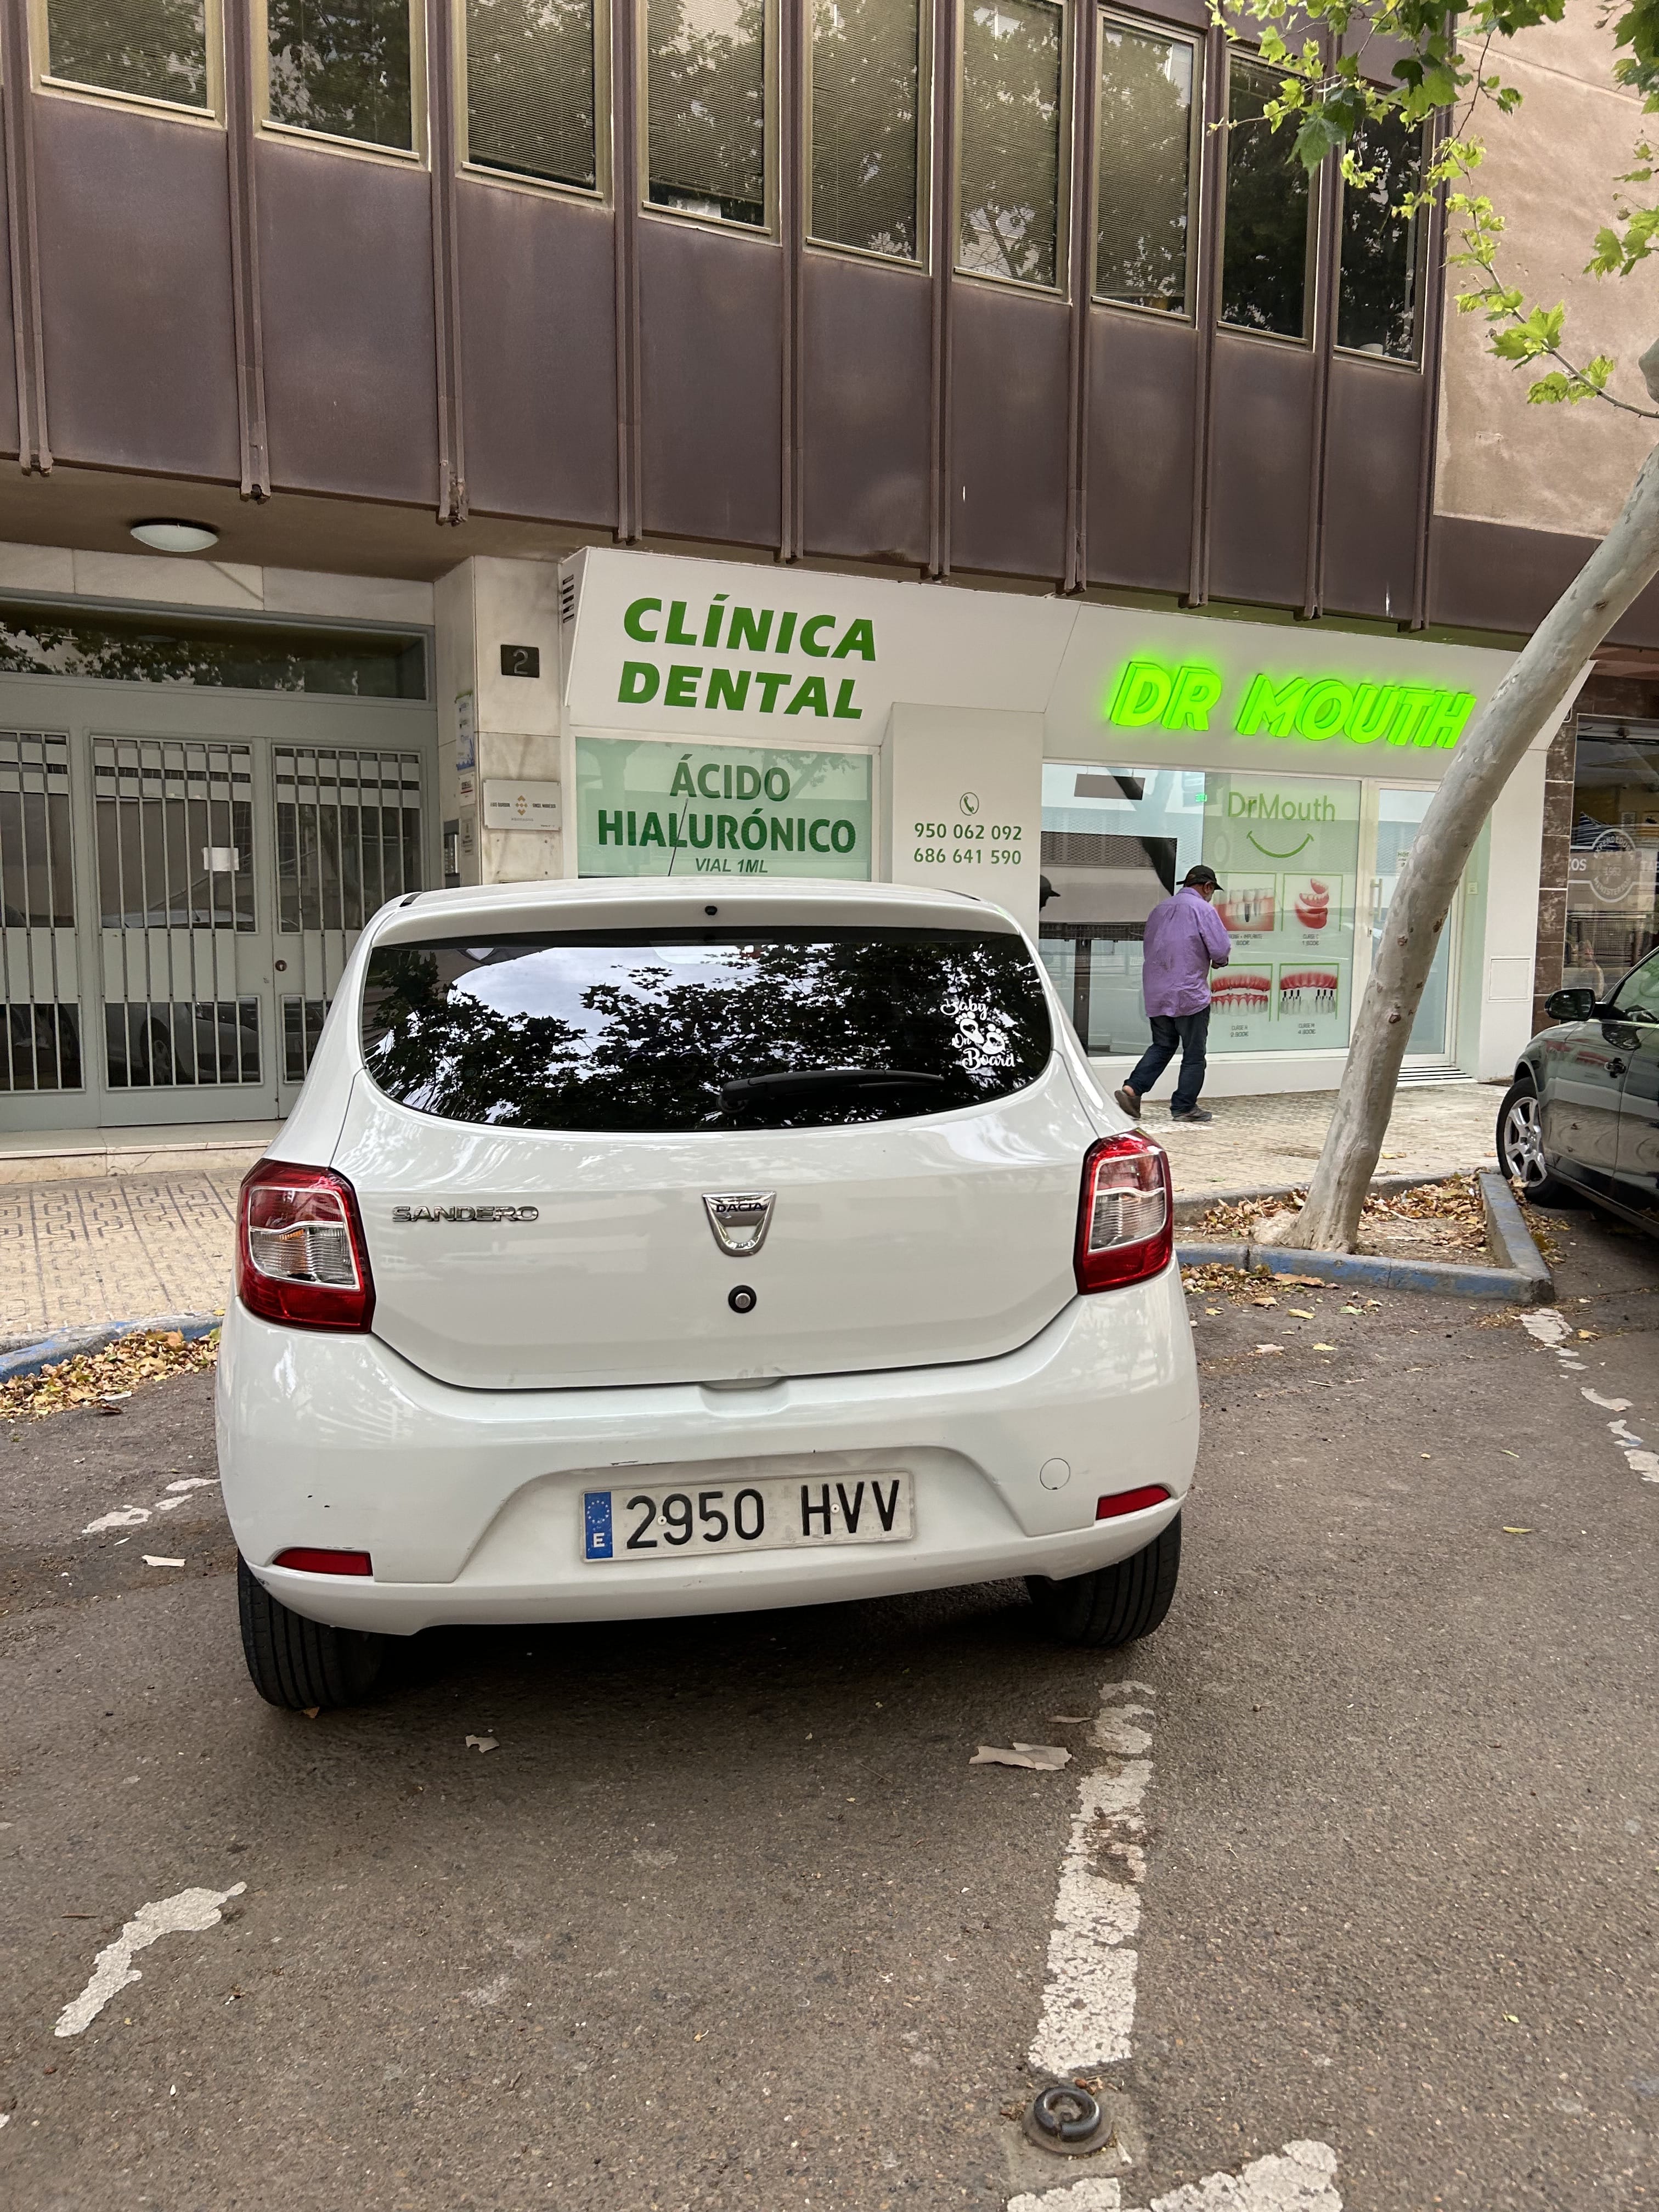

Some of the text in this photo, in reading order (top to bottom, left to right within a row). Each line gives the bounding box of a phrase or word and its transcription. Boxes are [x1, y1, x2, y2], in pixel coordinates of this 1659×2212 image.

[624, 594, 877, 662] CLÍNICA
[513, 648, 528, 675] 2
[617, 661, 864, 719] DENTAL
[1110, 661, 1477, 749] DR MOUTH
[669, 753, 791, 802] ÁCIDO
[1228, 792, 1335, 822] DrMouth
[598, 808, 856, 853] HIALURÓNICO
[914, 823, 1022, 840] 950 062 092
[696, 858, 768, 873] VIAL 1ML
[913, 848, 1021, 865] 686 641 590
[940, 998, 988, 1020] Baby
[952, 1033, 972, 1048] On
[961, 1047, 1015, 1070] Board
[392, 1205, 539, 1222] SANDERO
[716, 1203, 763, 1213] DACIA
[626, 1479, 900, 1549] 2950 HVV
[593, 1532, 605, 1548] E
